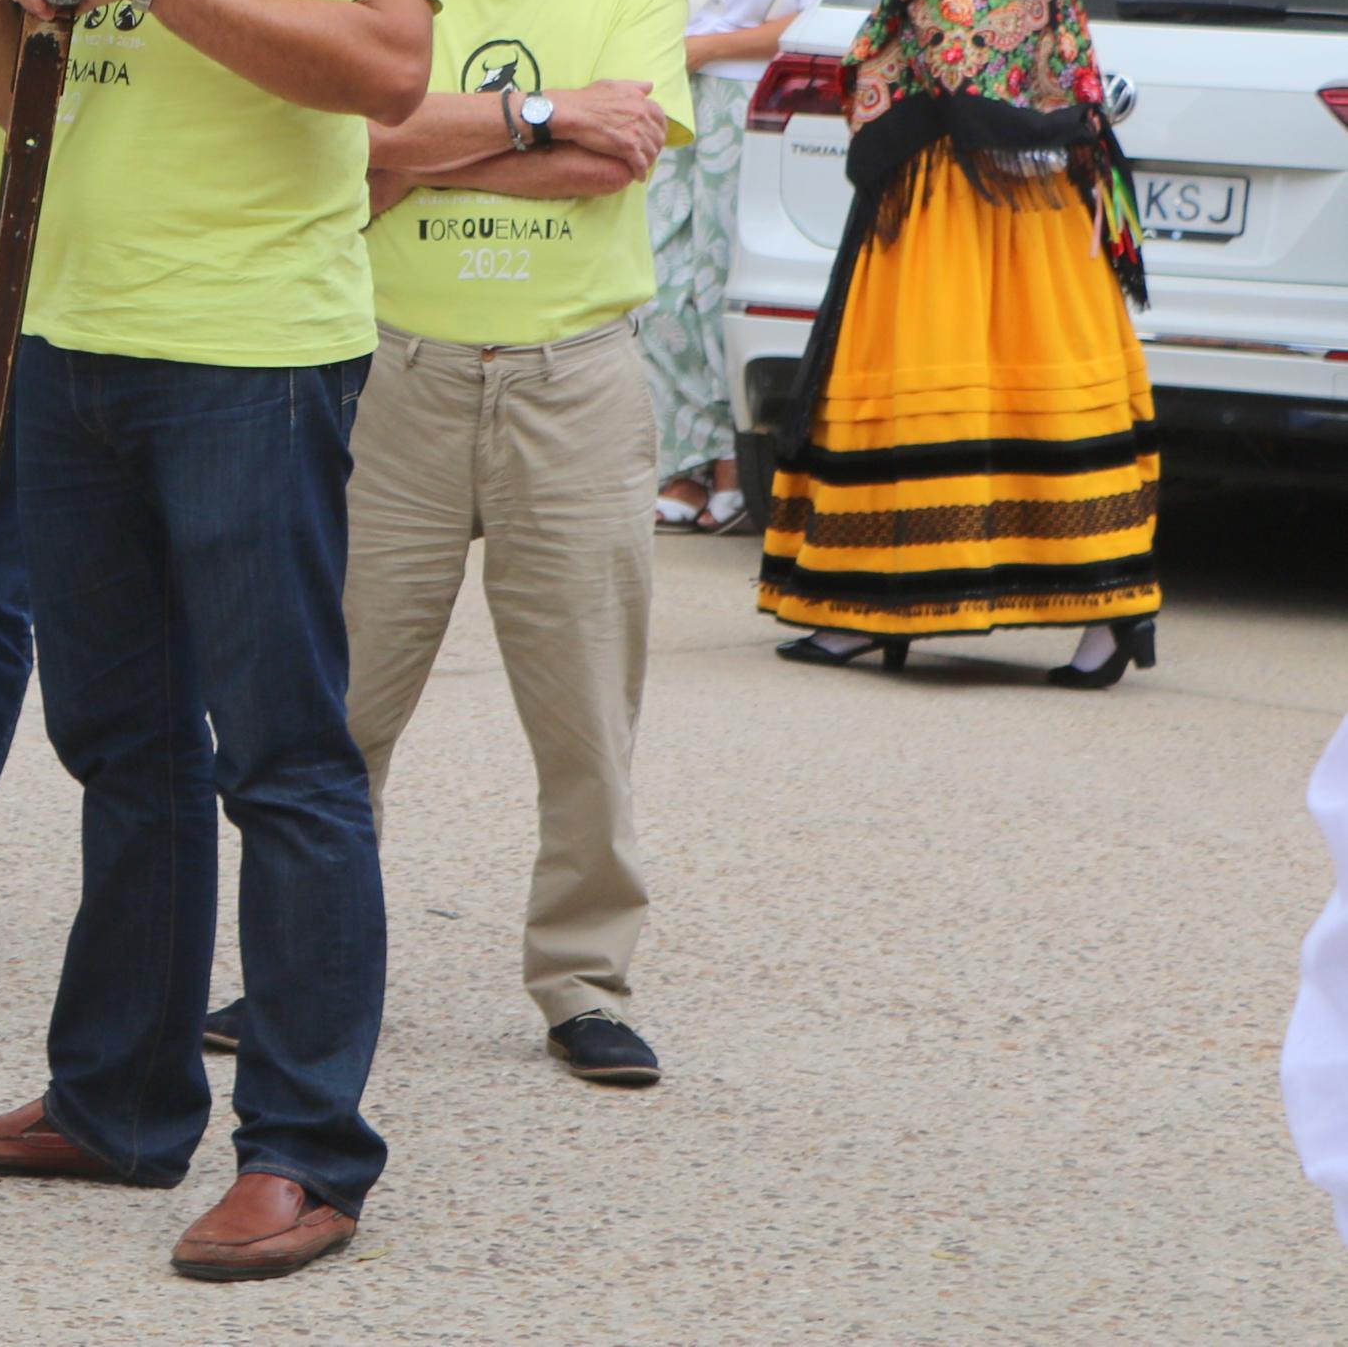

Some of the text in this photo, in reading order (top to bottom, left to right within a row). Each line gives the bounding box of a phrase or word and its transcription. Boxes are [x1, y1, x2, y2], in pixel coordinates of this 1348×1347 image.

[1144, 180, 1235, 225] KSJ
[417, 218, 573, 241] TORQUEMADA
[458, 248, 531, 281] 2022
